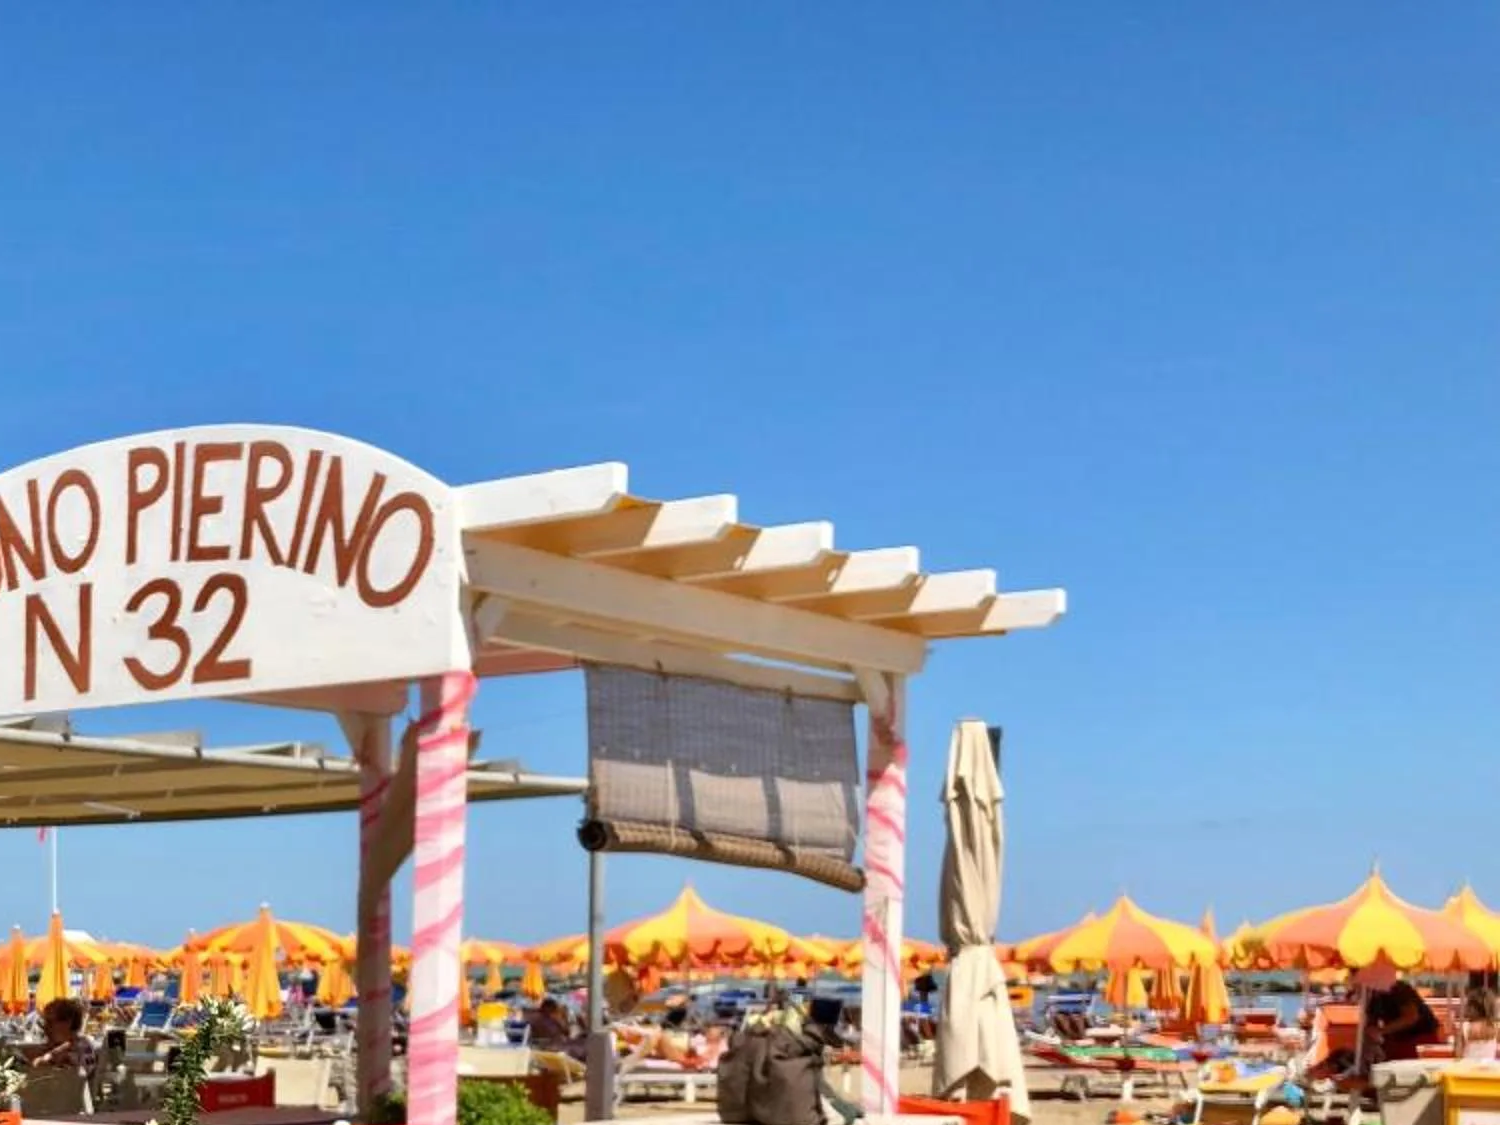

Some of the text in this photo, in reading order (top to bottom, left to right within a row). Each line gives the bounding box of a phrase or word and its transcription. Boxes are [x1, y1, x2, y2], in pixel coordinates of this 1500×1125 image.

[126, 439, 436, 608] PIERINO
[23, 572, 251, 701] N 32
